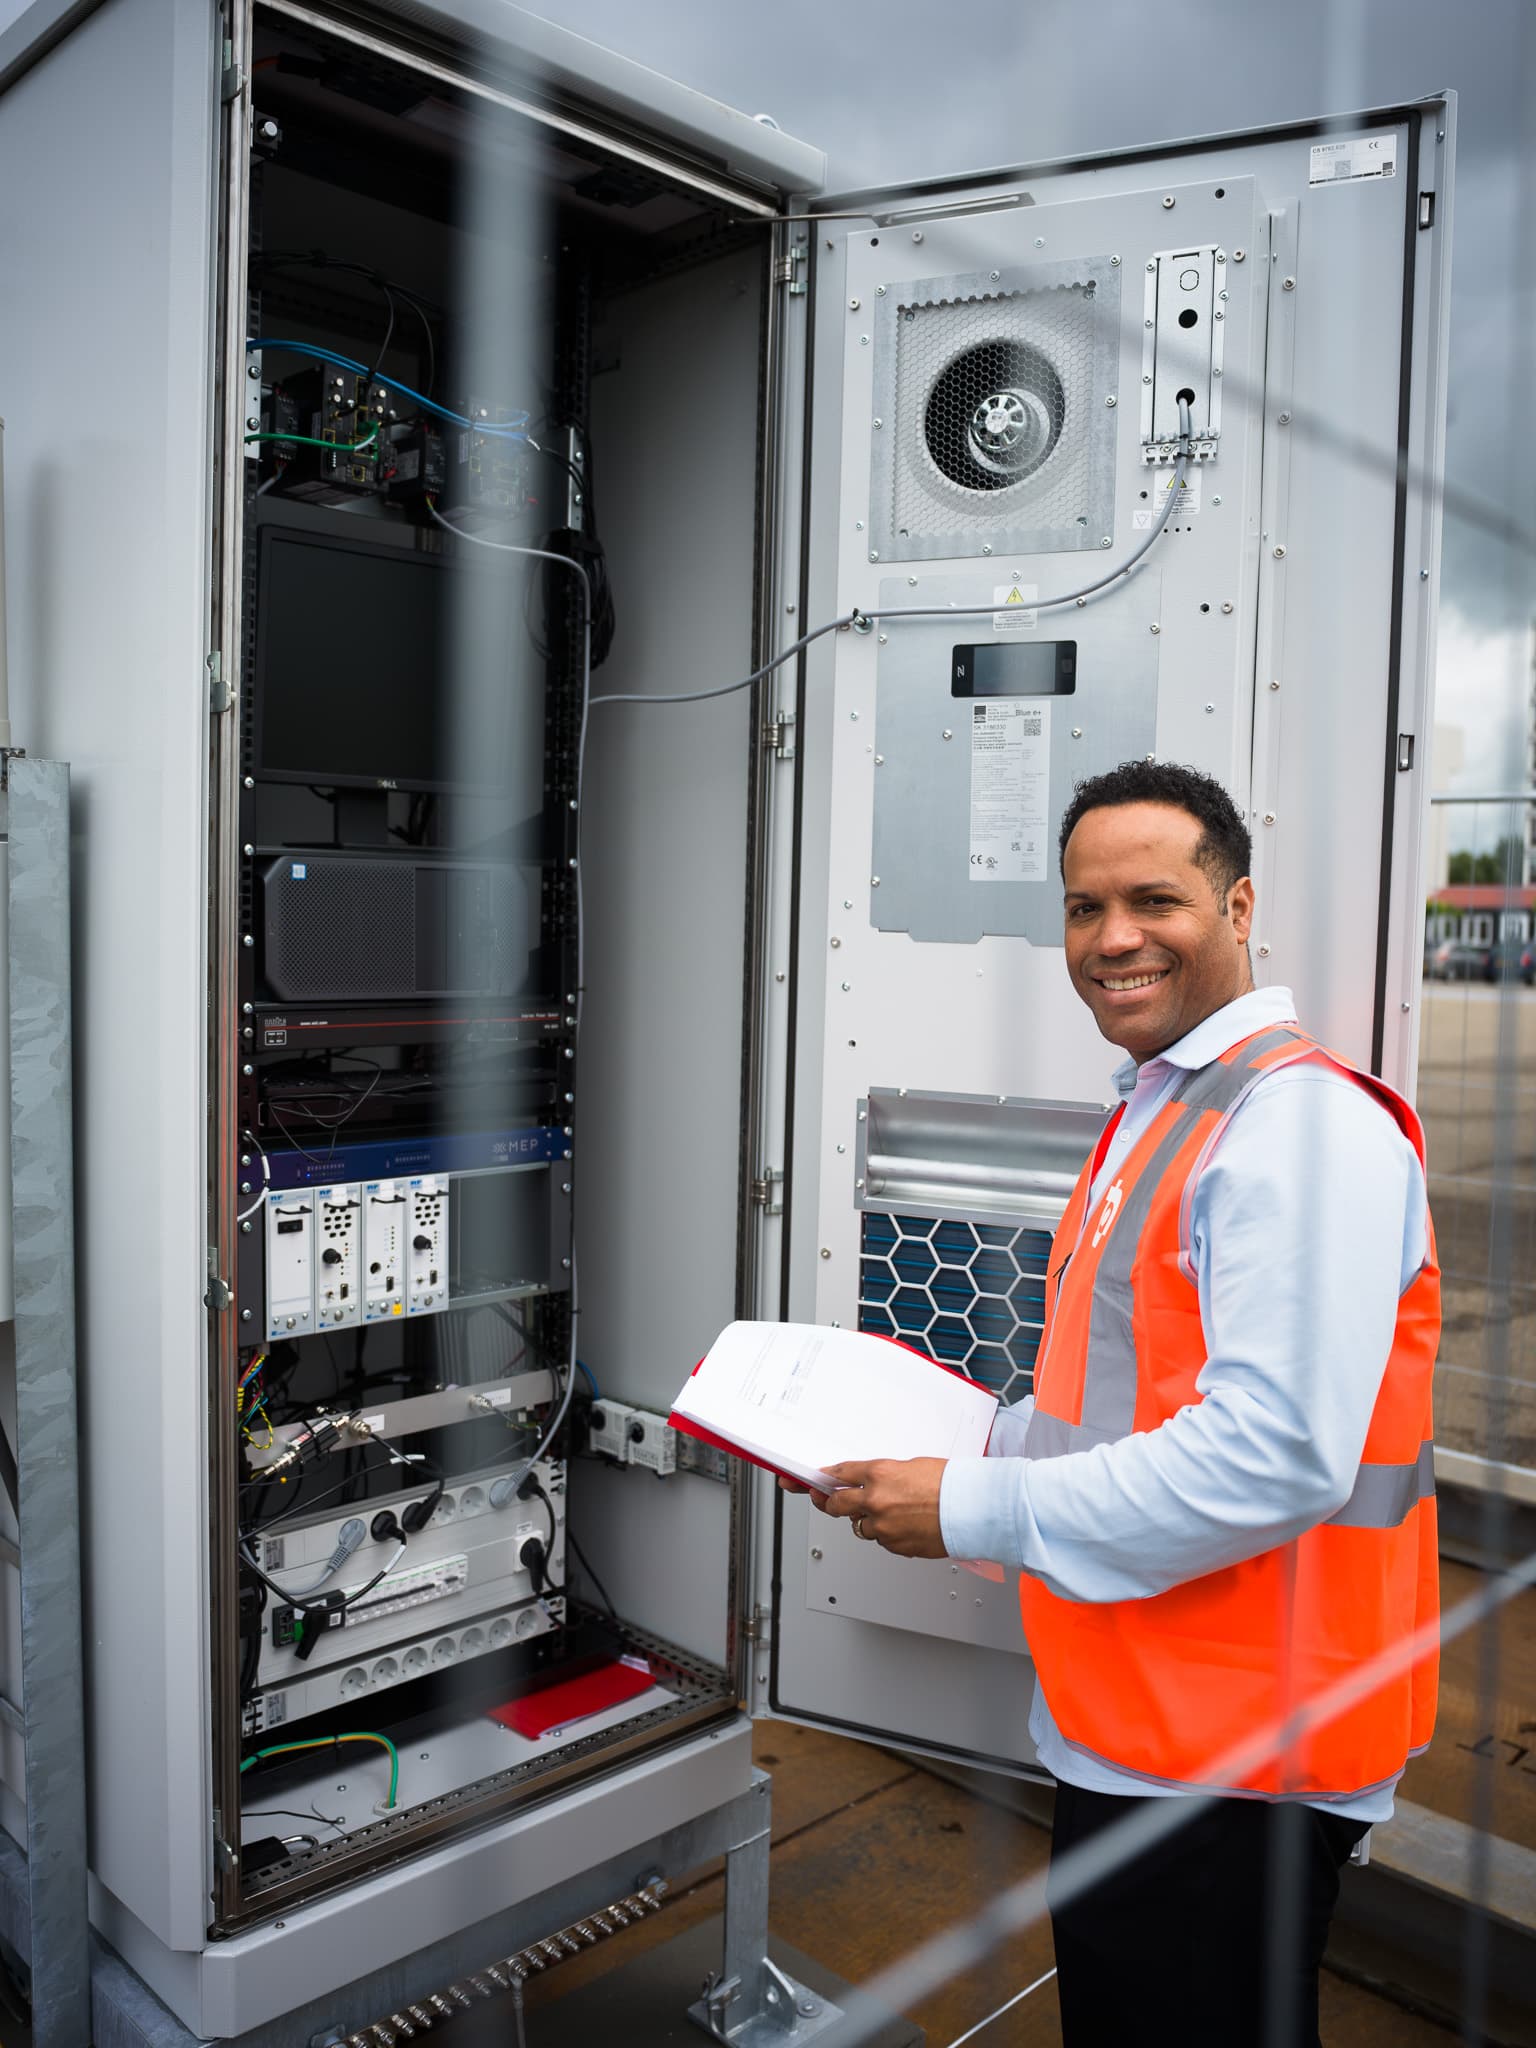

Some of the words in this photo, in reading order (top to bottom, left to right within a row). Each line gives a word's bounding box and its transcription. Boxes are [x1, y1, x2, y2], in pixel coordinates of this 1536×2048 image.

[1015, 709, 1032, 717] Blue
[970, 854, 983, 865] CE
[508, 1138, 538, 1153] MEP
